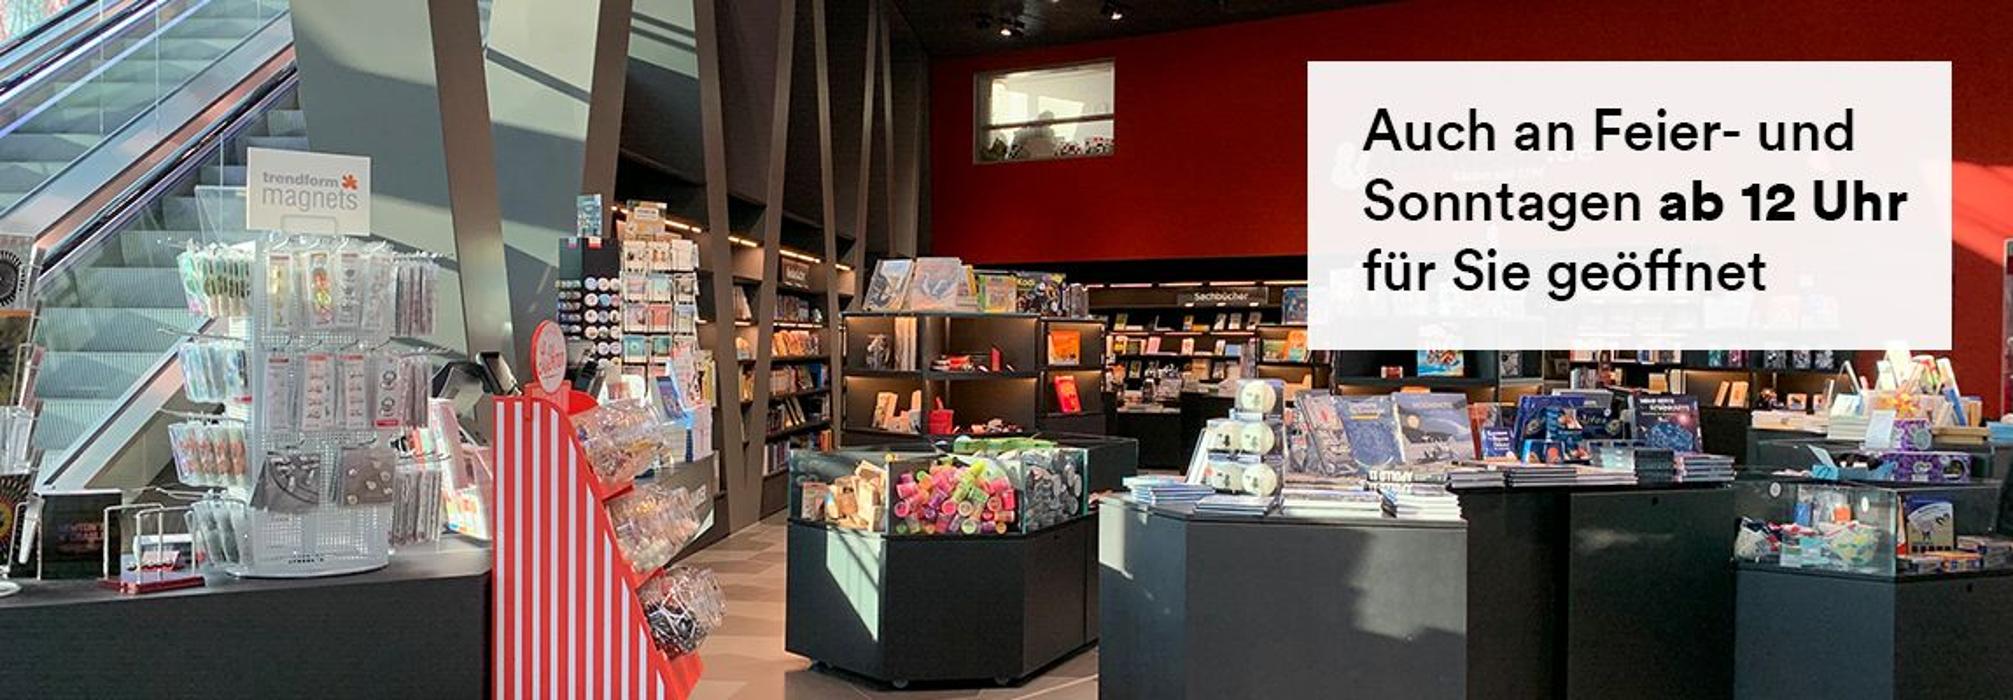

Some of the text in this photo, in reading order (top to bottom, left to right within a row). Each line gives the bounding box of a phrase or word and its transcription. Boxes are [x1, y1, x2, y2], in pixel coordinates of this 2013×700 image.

[263, 172, 338, 188] trendform
[262, 188, 358, 212] magnets
[1193, 291, 1249, 302] Sachbücher
